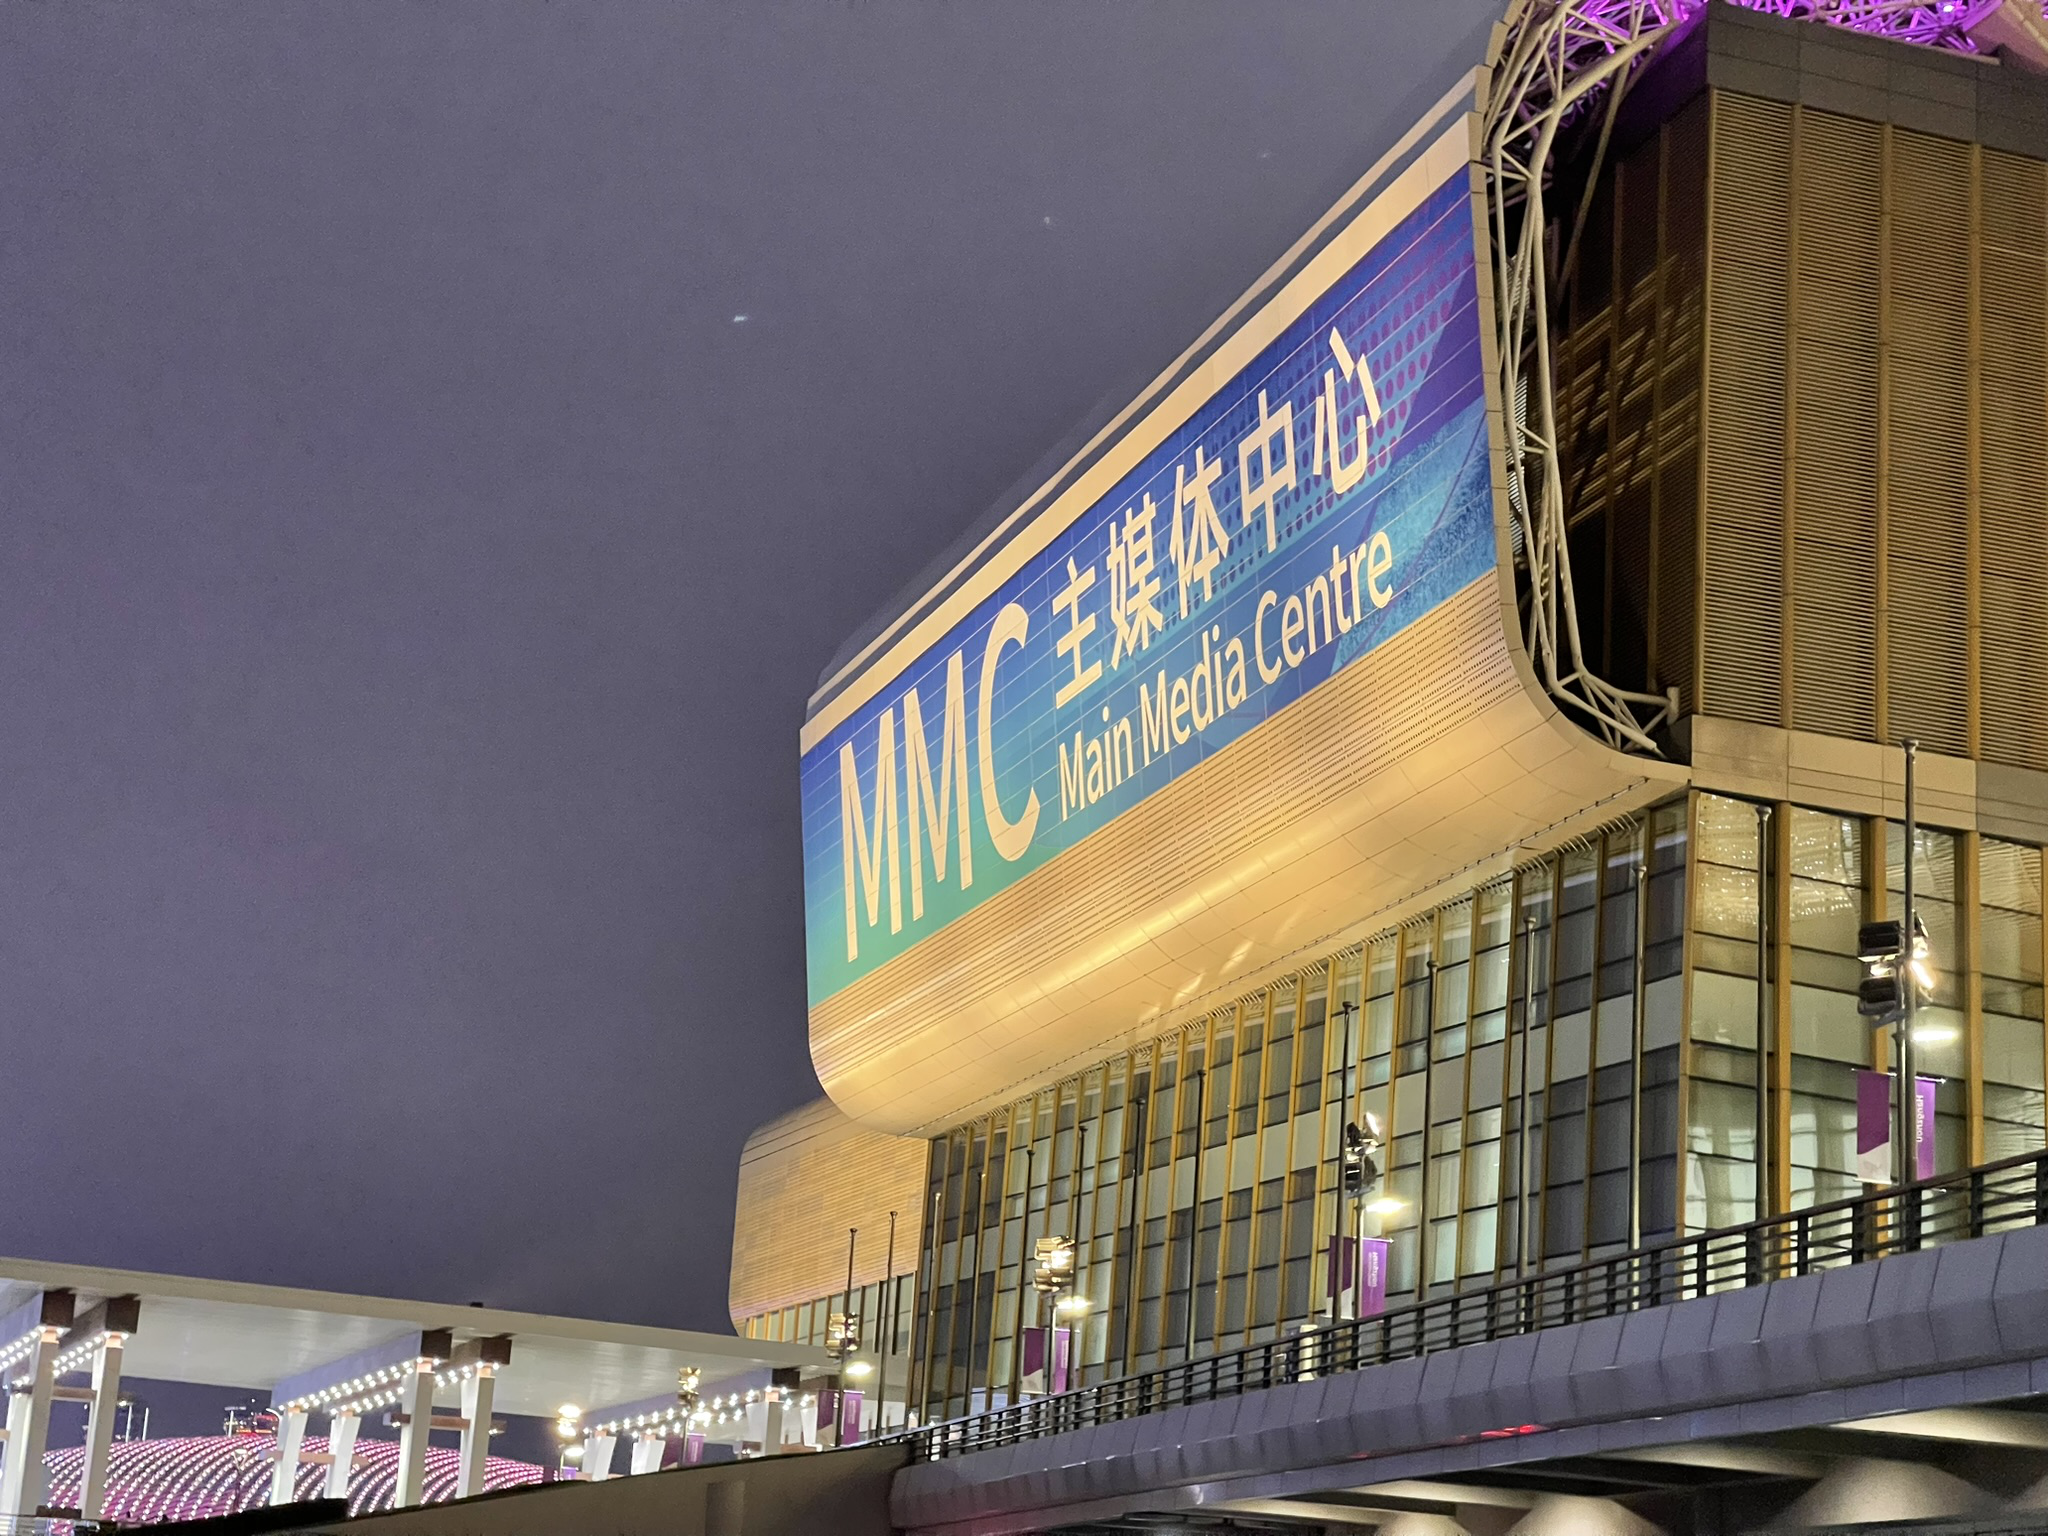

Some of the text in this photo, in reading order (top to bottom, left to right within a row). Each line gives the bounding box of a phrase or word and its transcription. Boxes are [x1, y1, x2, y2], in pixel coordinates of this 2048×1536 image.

[1052, 328, 1380, 708] 主媒体中心
[1059, 531, 1393, 820] Main Media Centre
[839, 603, 1039, 962] MMC
